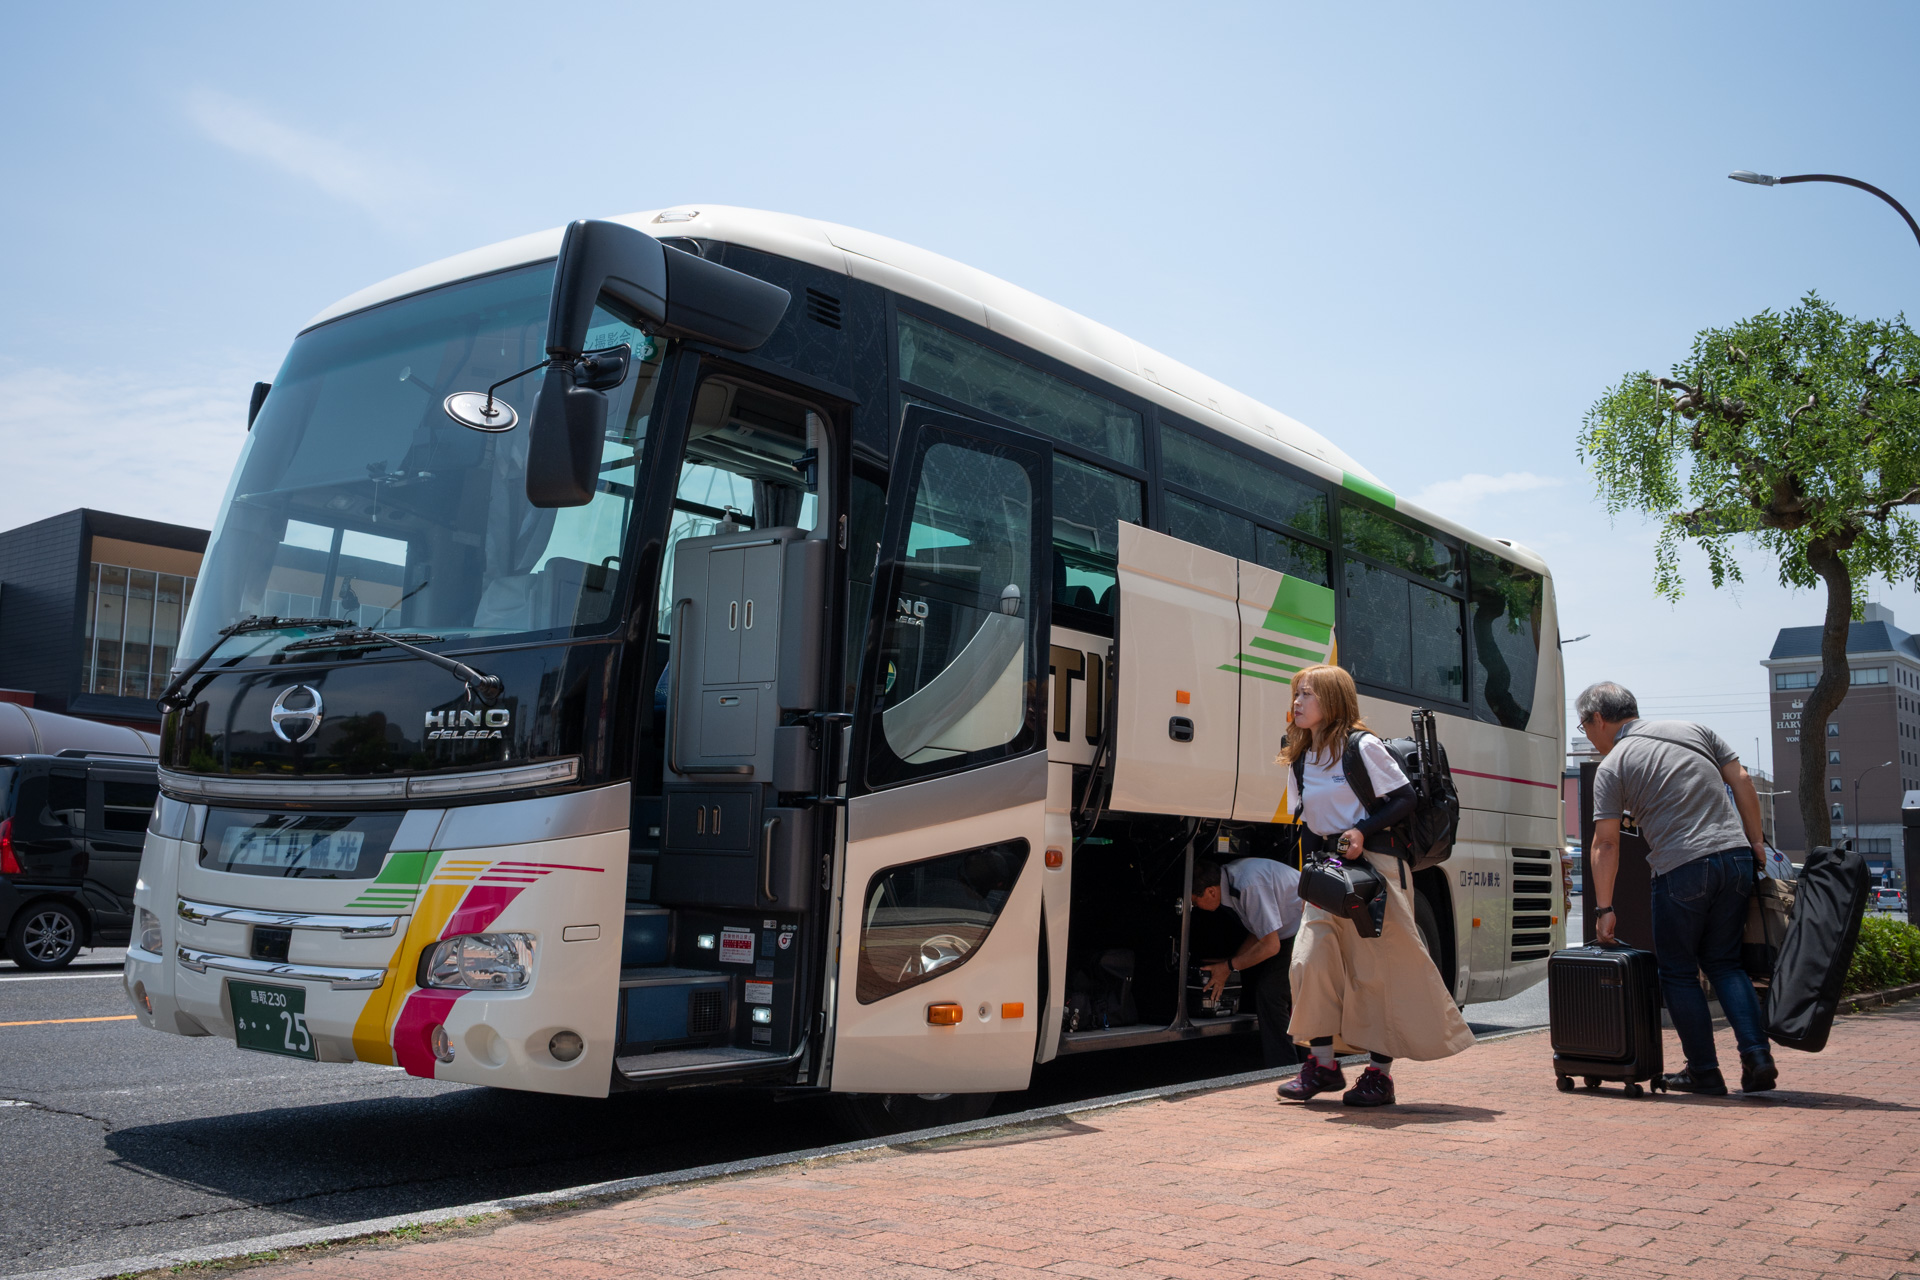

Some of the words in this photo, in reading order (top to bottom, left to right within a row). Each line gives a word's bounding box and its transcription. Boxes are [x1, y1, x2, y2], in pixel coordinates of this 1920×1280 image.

[897, 598, 929, 618] NO
[896, 616, 924, 627] EGA
[1049, 644, 1112, 746] TI
[425, 709, 510, 728] HINO
[1782, 712, 1802, 720] HOT
[1776, 721, 1801, 729] HARV
[428, 729, 502, 739] SELEGA
